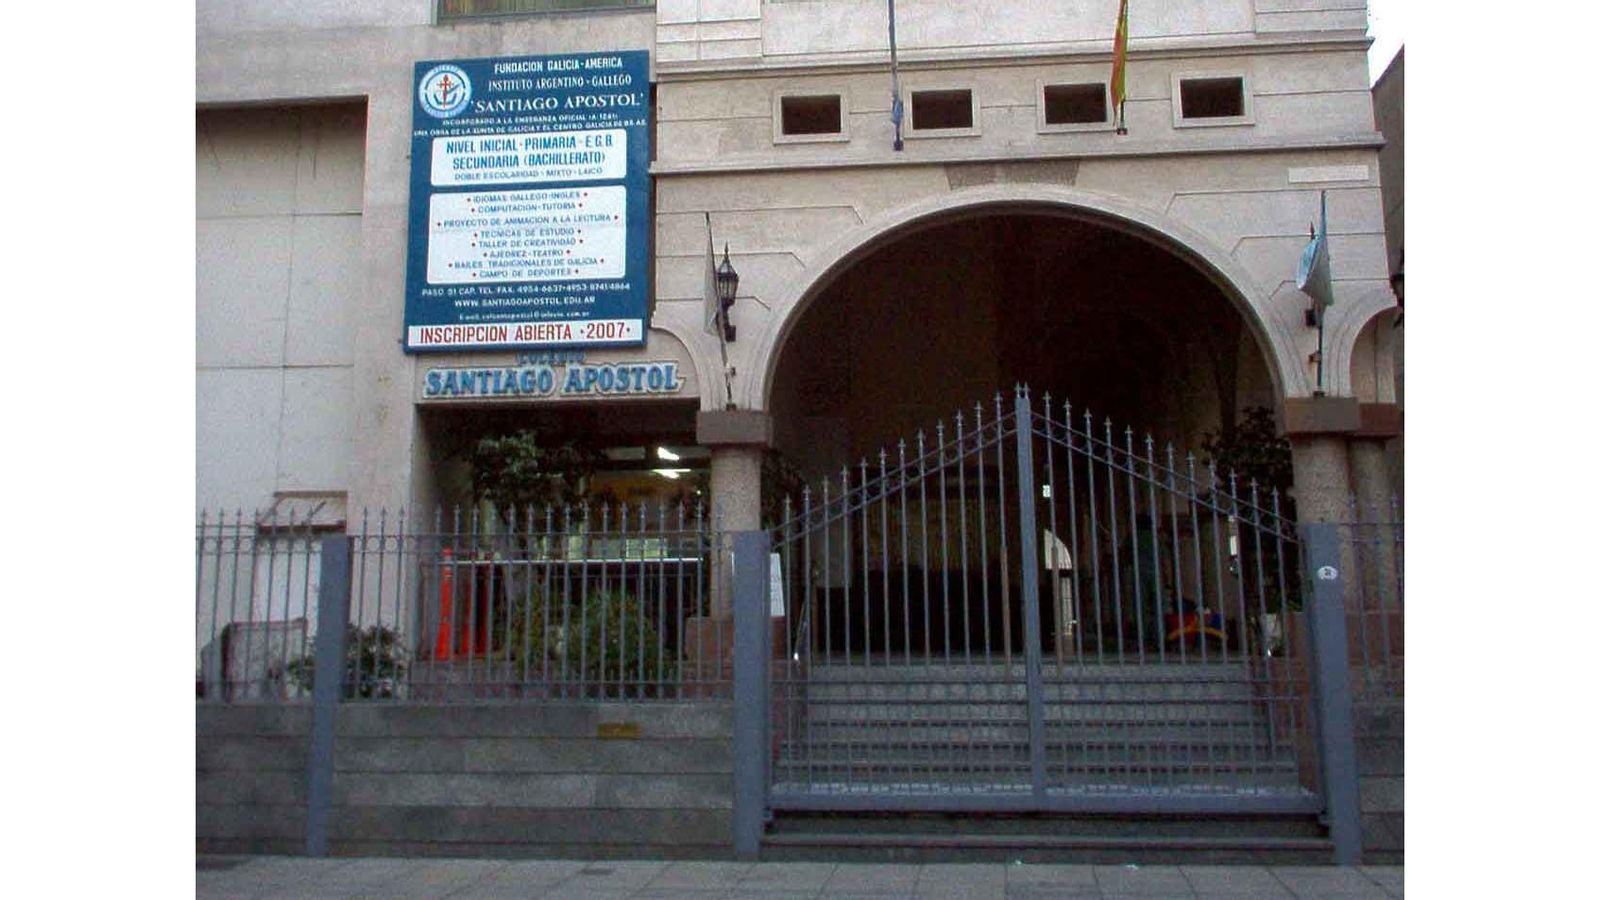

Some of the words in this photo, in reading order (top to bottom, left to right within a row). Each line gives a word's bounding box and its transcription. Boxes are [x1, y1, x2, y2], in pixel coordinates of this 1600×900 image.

[494, 61, 543, 75] FUNDACION
[488, 79, 533, 92] INSTITUTO
[536, 76, 584, 90] ARGENTINO
[591, 74, 632, 87] GALLEGO
[446, 141, 476, 154] NIVEL
[452, 155, 520, 170] SECUNDARIA
[523, 152, 606, 167] (BACHILLERATO)
[454, 172, 481, 181] DOBLE
[482, 169, 540, 179] ESCOLARIDAD
[444, 219, 489, 228] PROYECTO
[490, 218, 500, 226] DE
[504, 216, 550, 226] ANIMACION
[552, 215, 559, 223] A
[560, 215, 572, 223] LA
[573, 213, 611, 223] LECTURA
[480, 229, 521, 239] TECNICAS
[525, 229, 536, 237] DE
[539, 227, 575, 237] ESTUDIO
[479, 240, 507, 249] TALLER
[510, 240, 520, 248] DE
[524, 237, 577, 248] CREATIVIDAD
[454, 260, 483, 269] BAILES
[487, 258, 552, 268] TRADICIONALES
[553, 257, 564, 266] DE
[567, 256, 598, 266] GALICIA
[479, 269, 508, 278] CAMPO
[511, 269, 523, 278] DE
[527, 267, 572, 277] DEPORTES
[421, 288, 445, 297] PASO
[420, 325, 508, 344] INSCRIPCION
[514, 323, 572, 341] ABIERTA
[425, 368, 553, 396] SANTIAGO
[562, 364, 680, 394] APOSTOL
